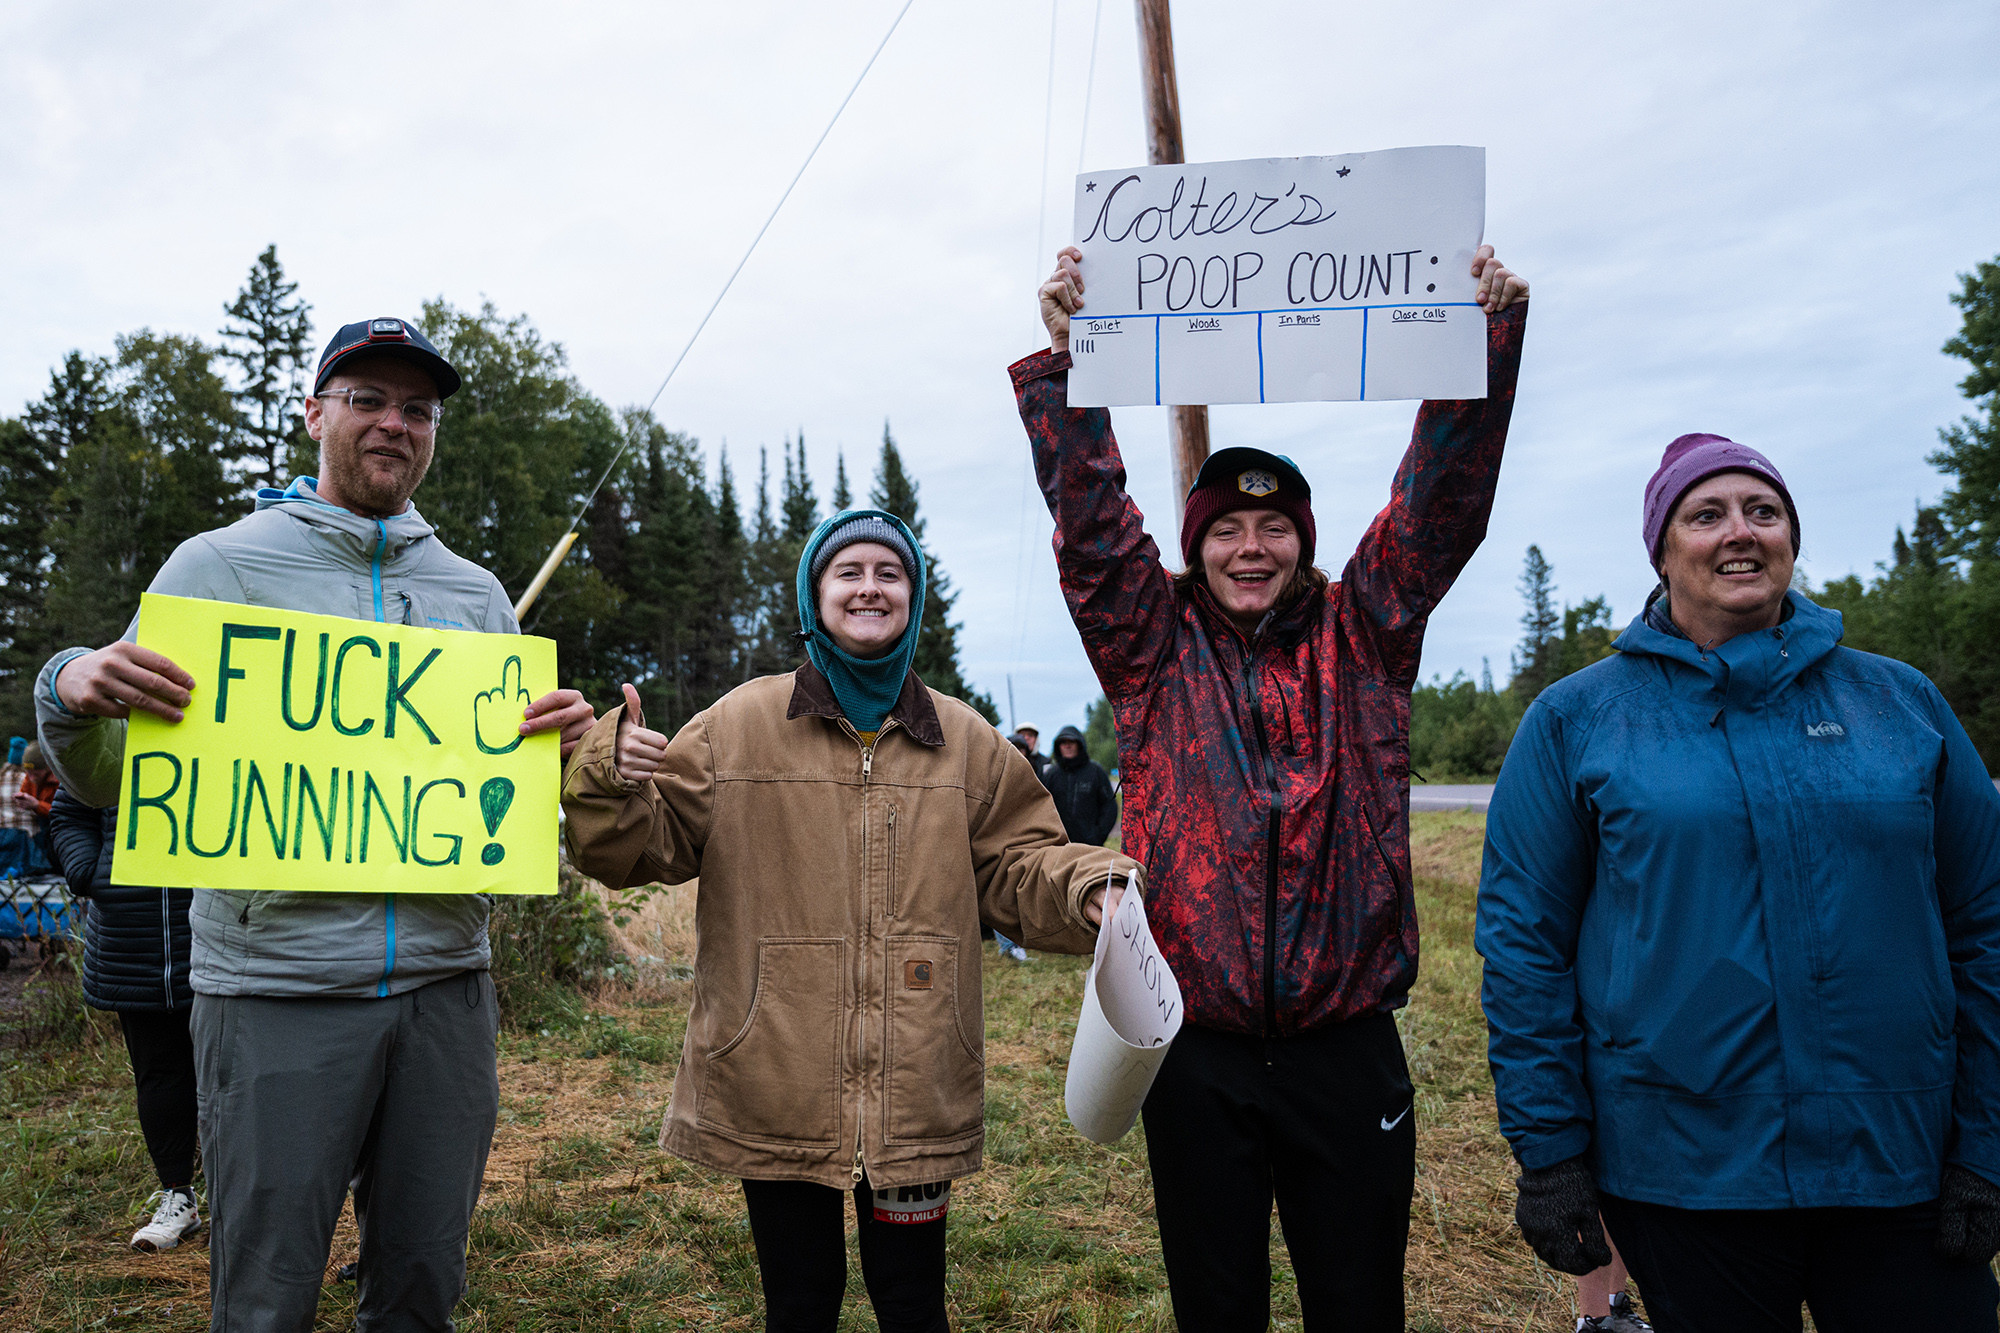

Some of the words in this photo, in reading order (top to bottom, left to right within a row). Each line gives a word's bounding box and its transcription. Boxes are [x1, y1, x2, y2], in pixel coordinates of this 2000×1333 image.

[1082, 174, 1337, 244] Colter's
[1137, 251, 1264, 312] POOP
[1287, 249, 1440, 305] COUNT:
[1087, 319, 1121, 332] Toilet
[1188, 318, 1221, 330] Woods
[1278, 315, 1293, 325] In
[1296, 313, 1321, 324] Pants
[1392, 309, 1418, 321] Close
[1422, 308, 1446, 319] Calls
[215, 623, 443, 745] FUCK
[126, 750, 516, 867] RUNNING!
[1120, 901, 1175, 1024] SHOW
[887, 1211, 909, 1222] 100
[912, 1208, 940, 1222] MILE
